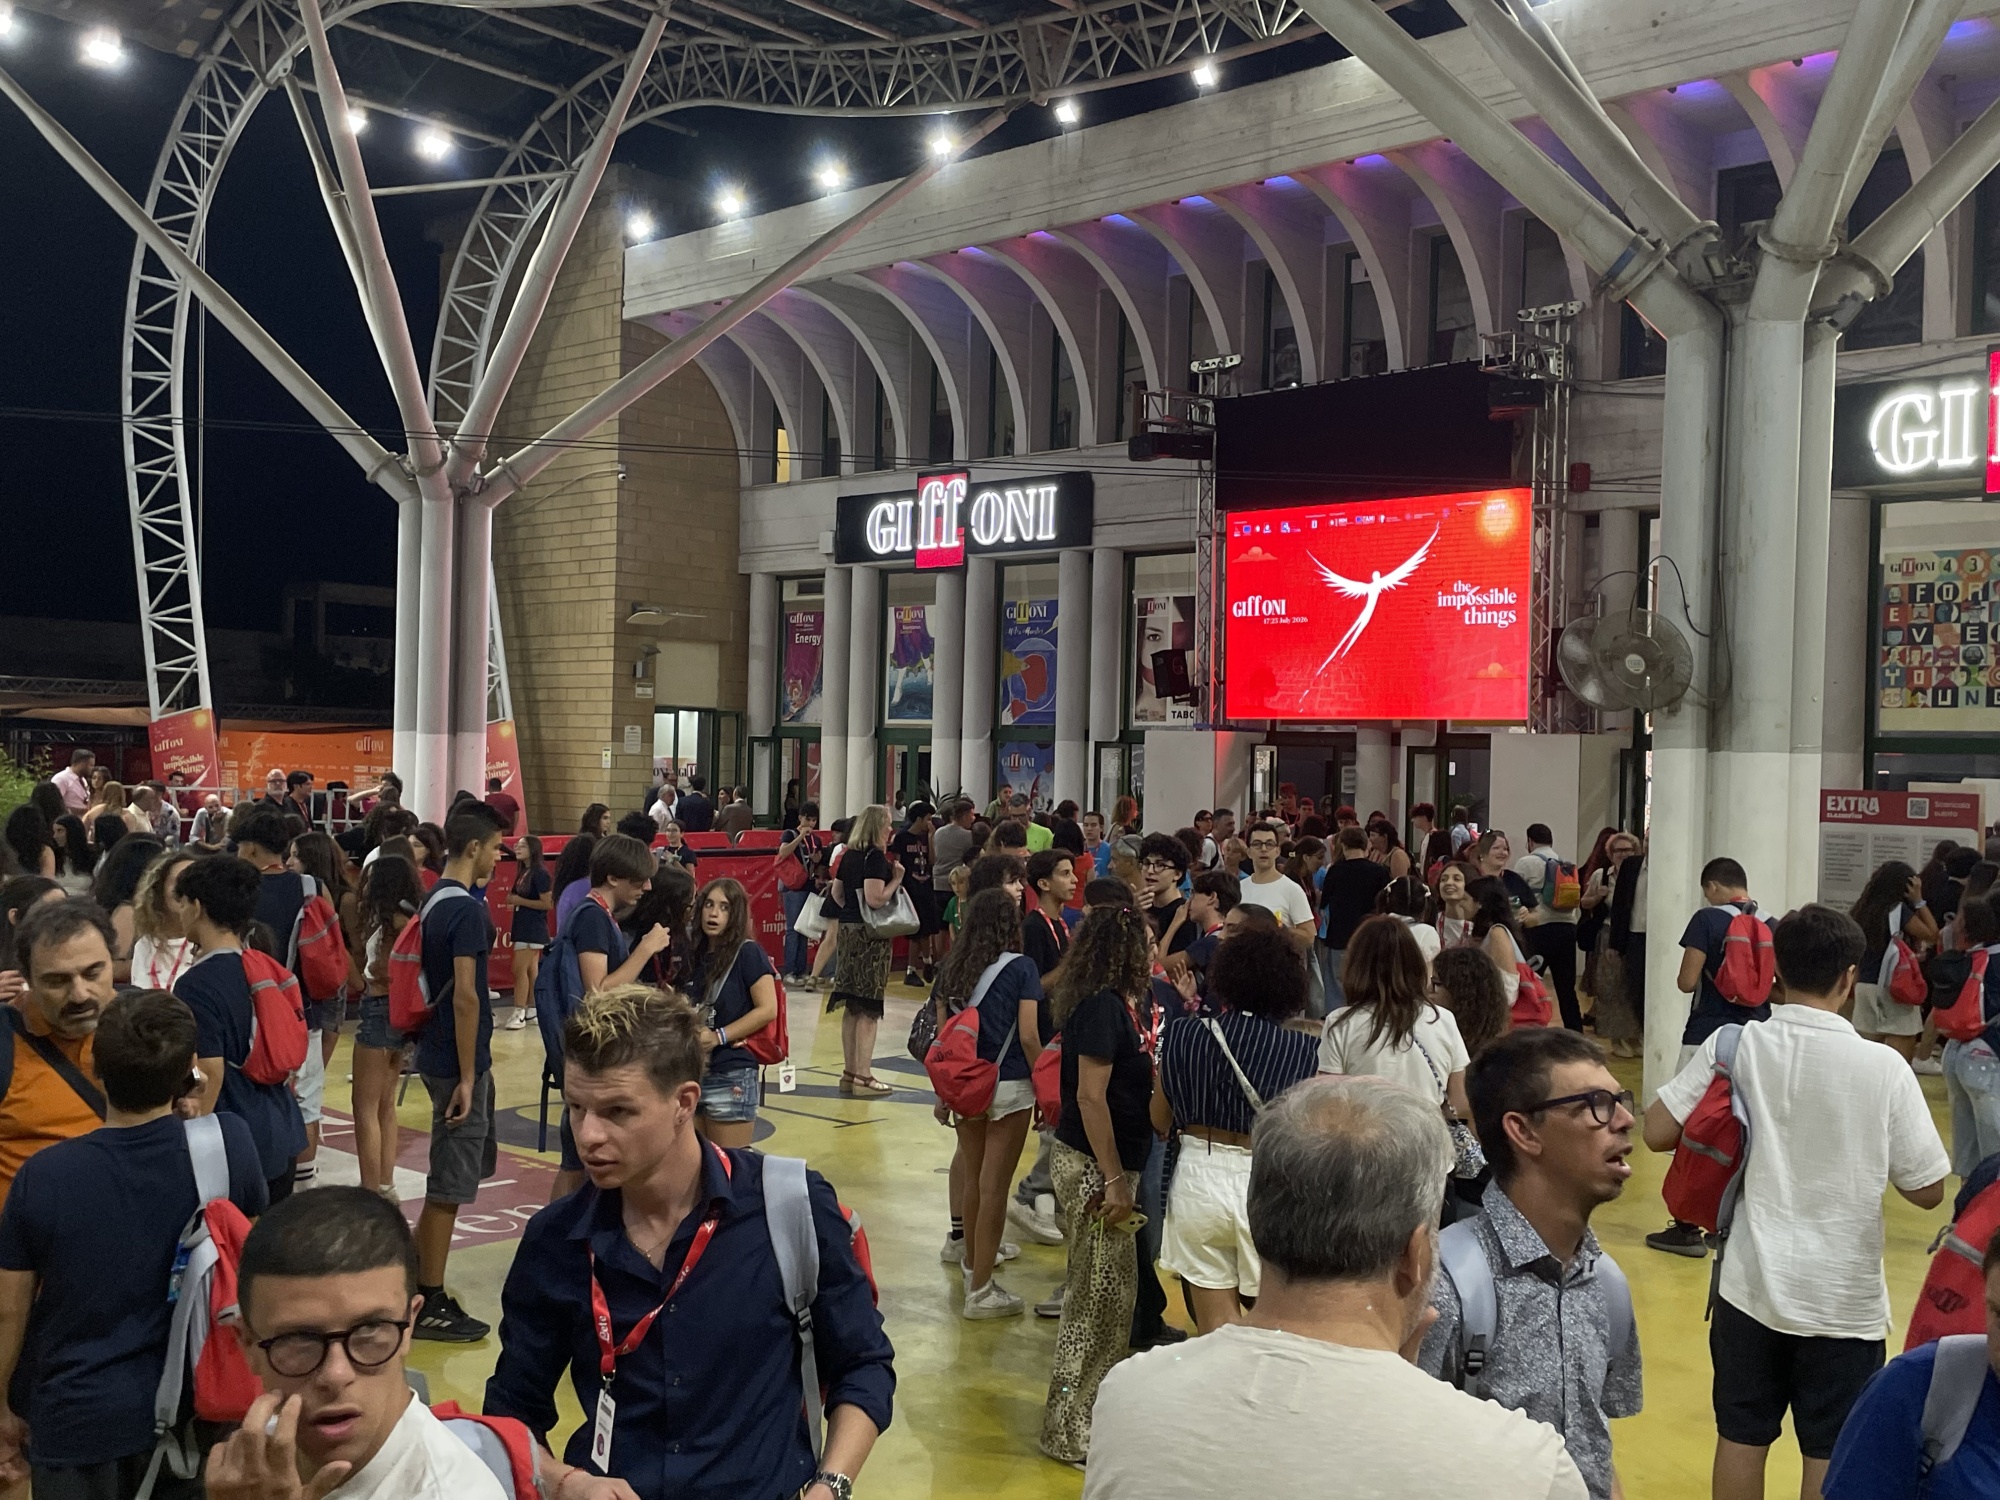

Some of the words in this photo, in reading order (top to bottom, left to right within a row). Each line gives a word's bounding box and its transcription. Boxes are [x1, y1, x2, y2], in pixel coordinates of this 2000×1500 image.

[1869, 386, 2000, 472] GI
[1453, 580, 1472, 593] the
[1437, 586, 1518, 611] impossible
[1291, 616, 1309, 624] 2026
[1464, 606, 1517, 629] things
[795, 632, 822, 646] Energy
[1826, 795, 1880, 816] EXTRA
